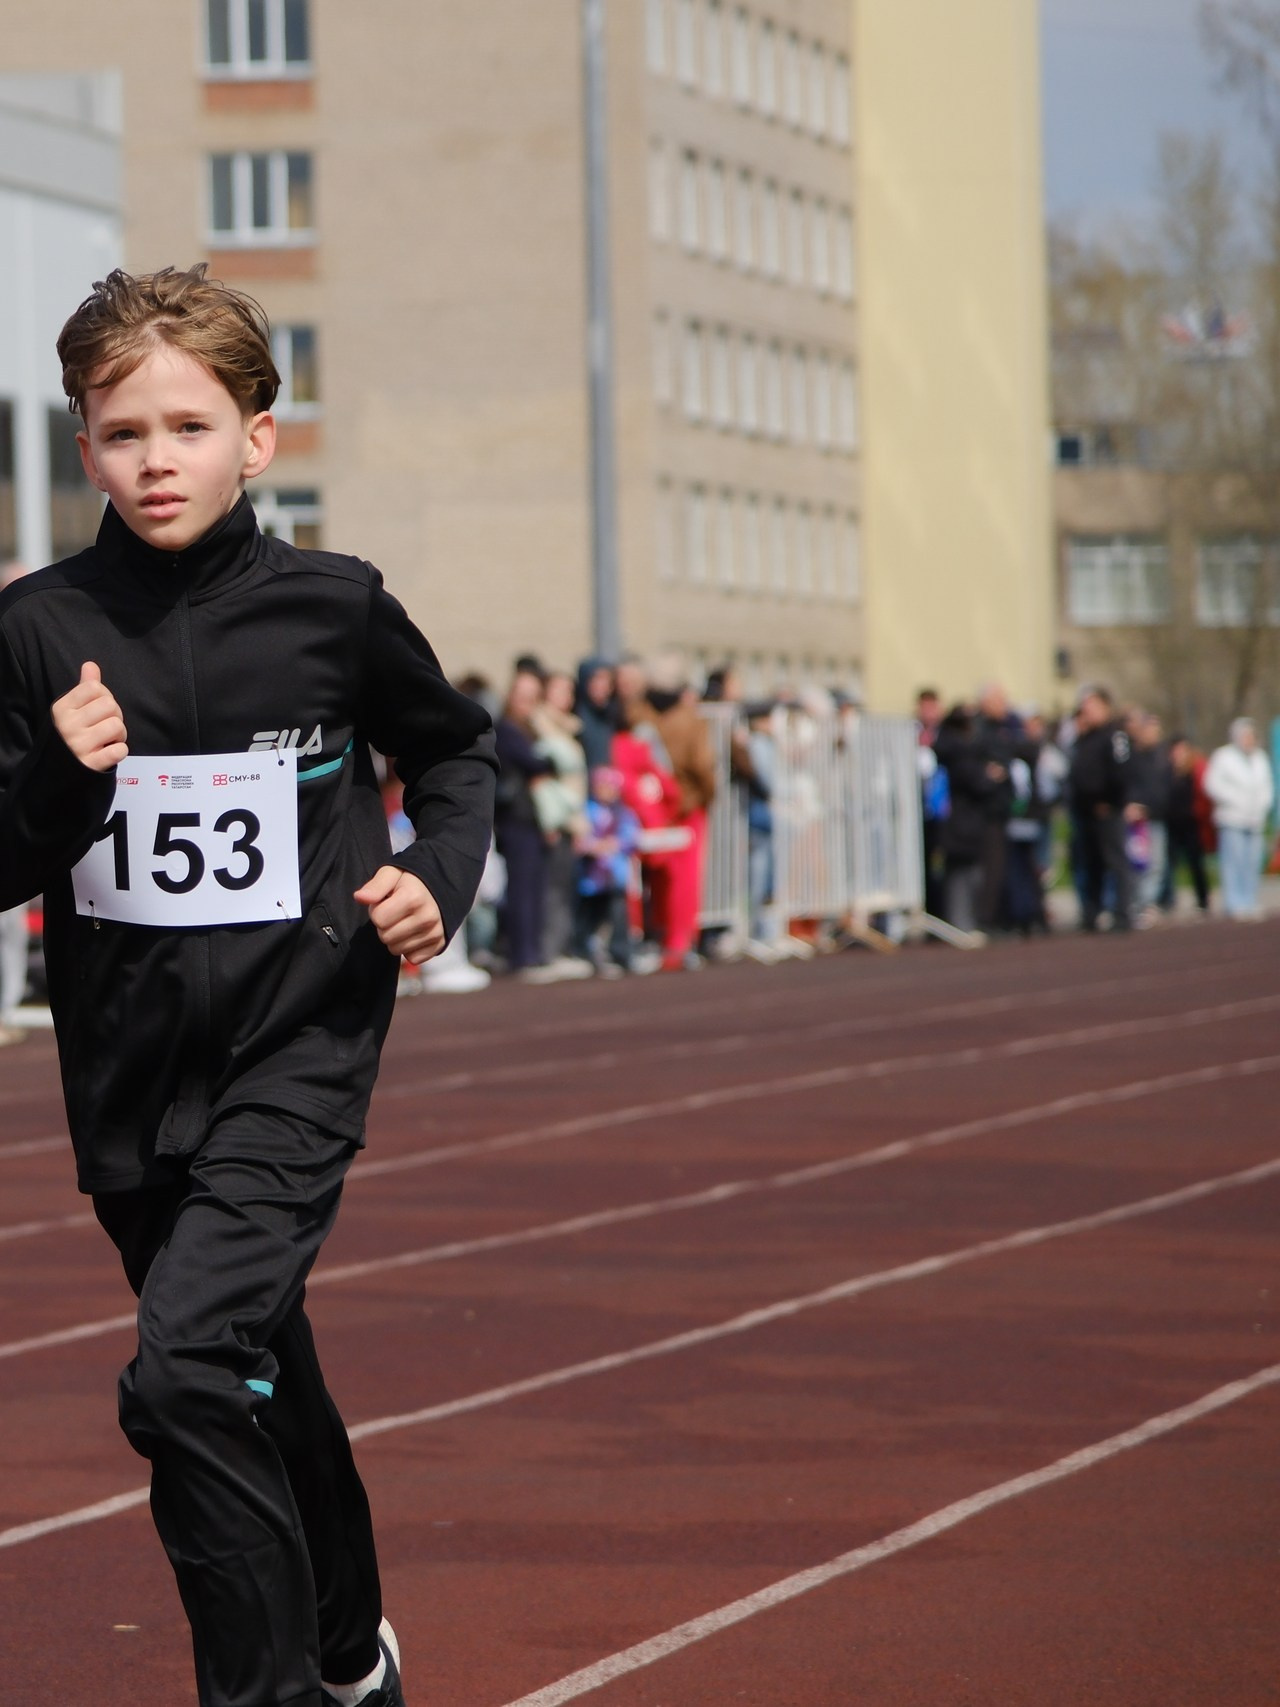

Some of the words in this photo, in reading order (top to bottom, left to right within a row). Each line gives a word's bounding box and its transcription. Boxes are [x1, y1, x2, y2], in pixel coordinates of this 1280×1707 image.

[248, 724, 322, 757] FILA
[116, 777, 139, 785] ПОРТ
[94, 808, 265, 895] 153
